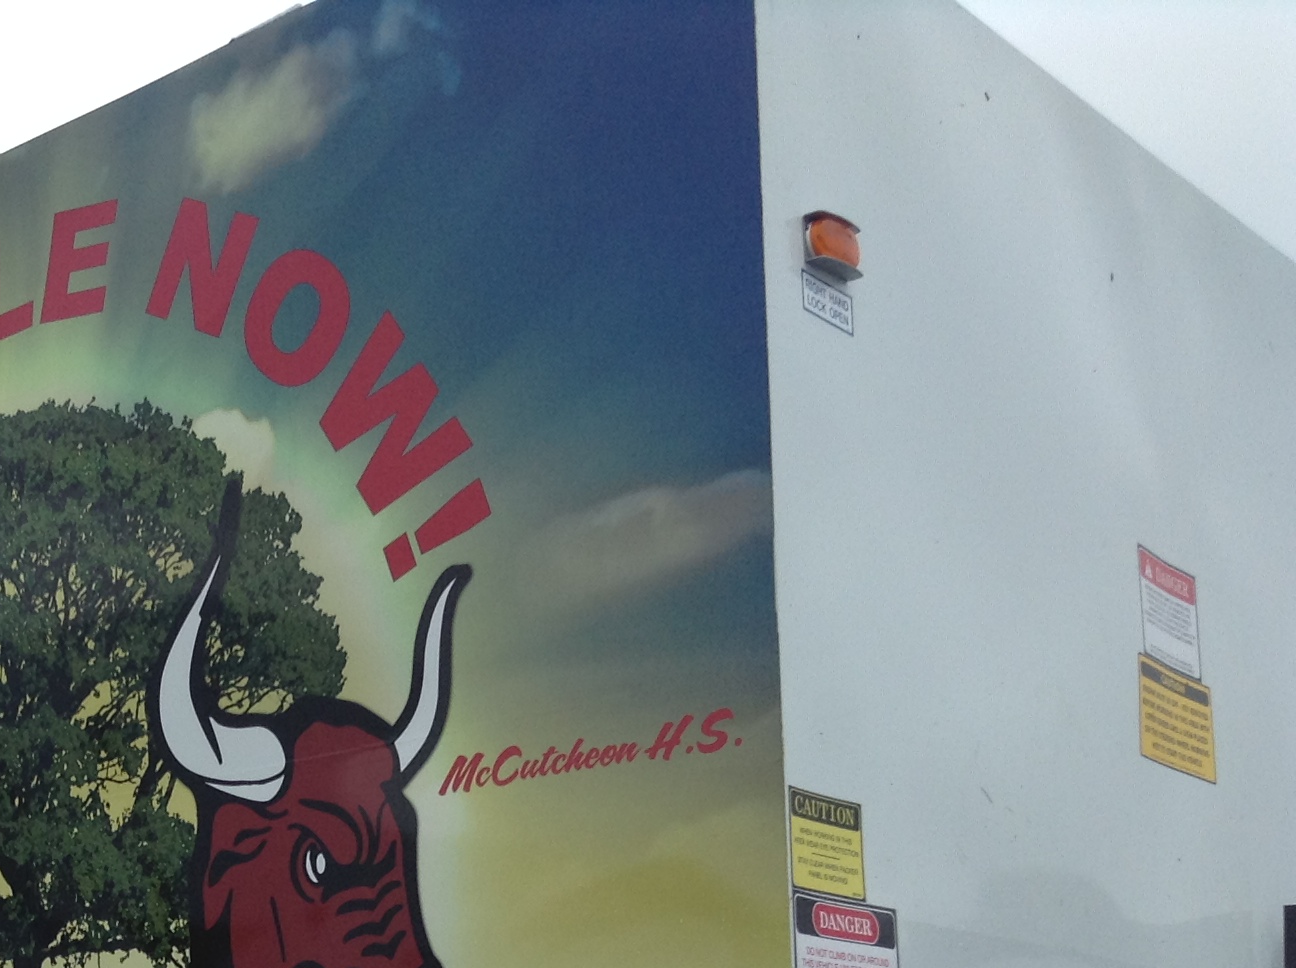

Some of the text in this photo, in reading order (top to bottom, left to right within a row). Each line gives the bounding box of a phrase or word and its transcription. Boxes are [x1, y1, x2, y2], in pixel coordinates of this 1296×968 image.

[145, 197, 492, 581] NOW!
[438, 707, 743, 796] McCutcheon H.S.
[794, 795, 855, 826] CAUTION
[819, 911, 873, 937] DANGER
